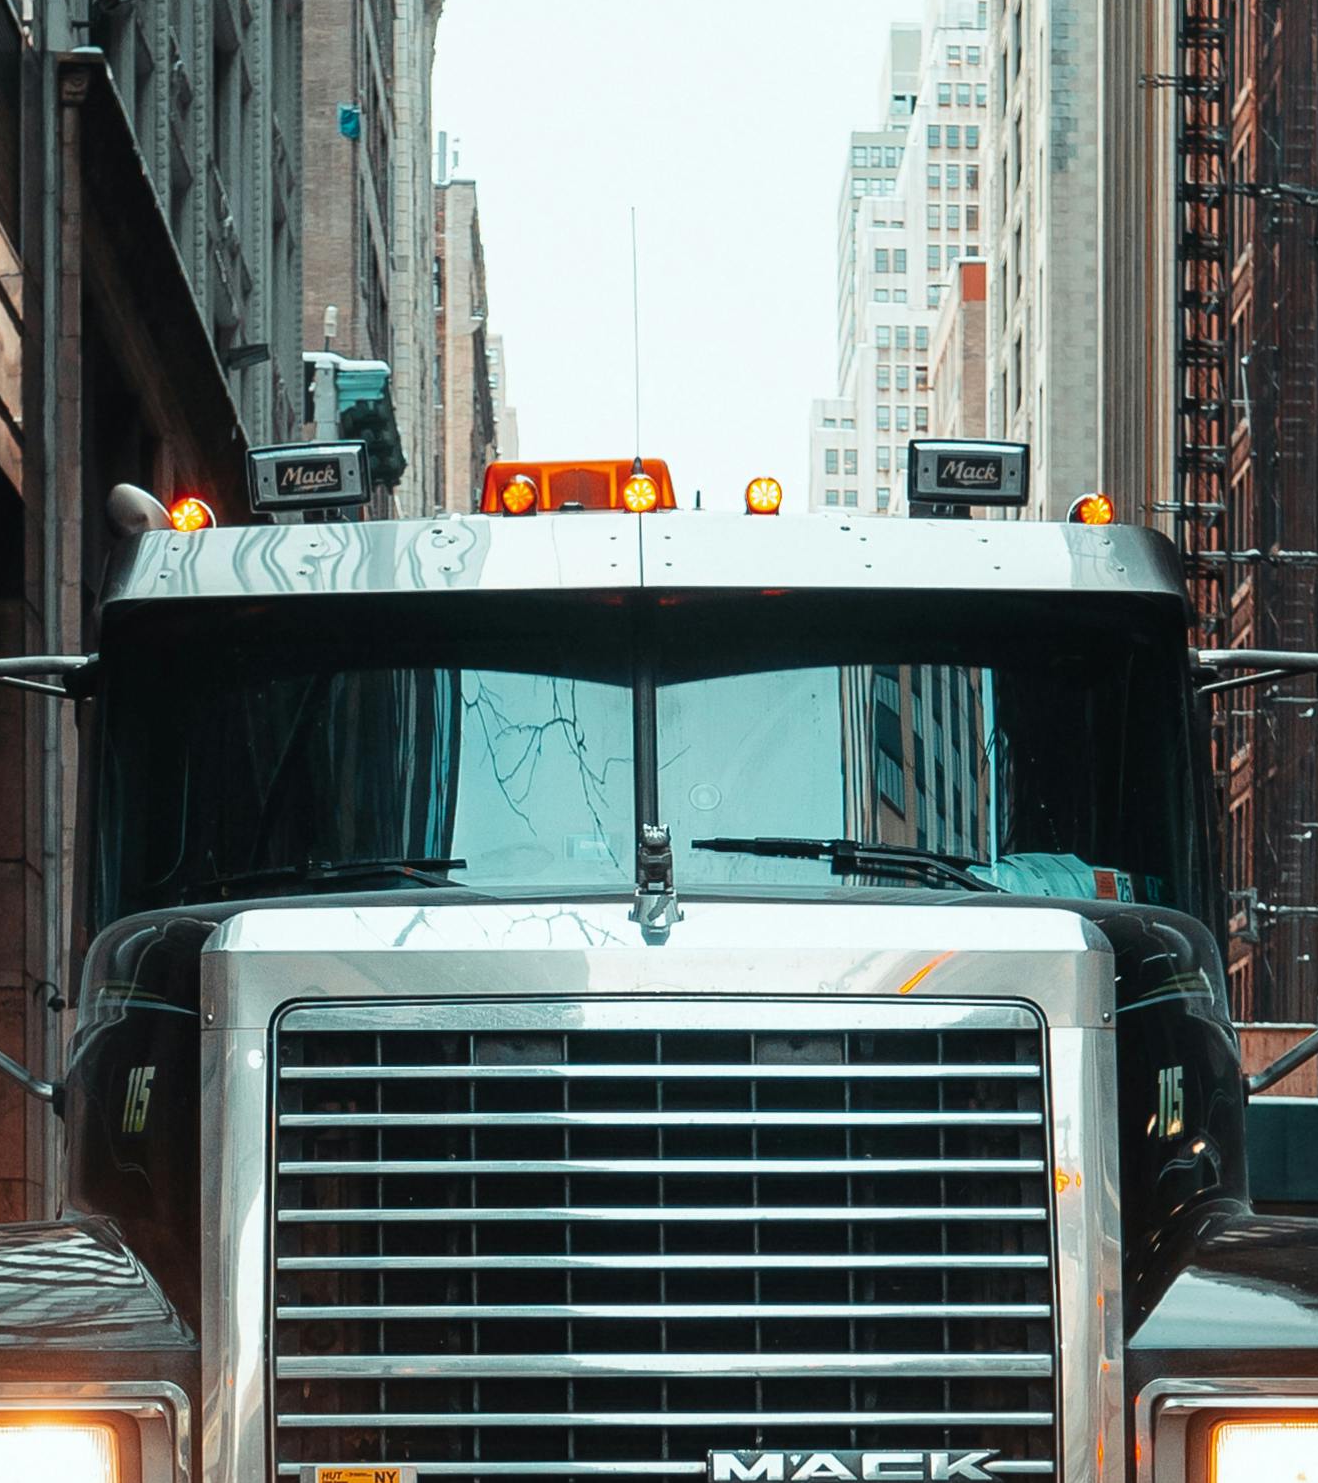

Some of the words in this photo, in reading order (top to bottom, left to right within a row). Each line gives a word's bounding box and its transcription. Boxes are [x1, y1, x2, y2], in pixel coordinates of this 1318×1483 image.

[280, 464, 339, 489] Mack
[940, 460, 999, 484] Mack
[121, 1066, 156, 1133] 115
[1157, 1065, 1185, 1138] 115
[321, 1471, 344, 1481] HUT
[710, 1451, 993, 1483] MACK
